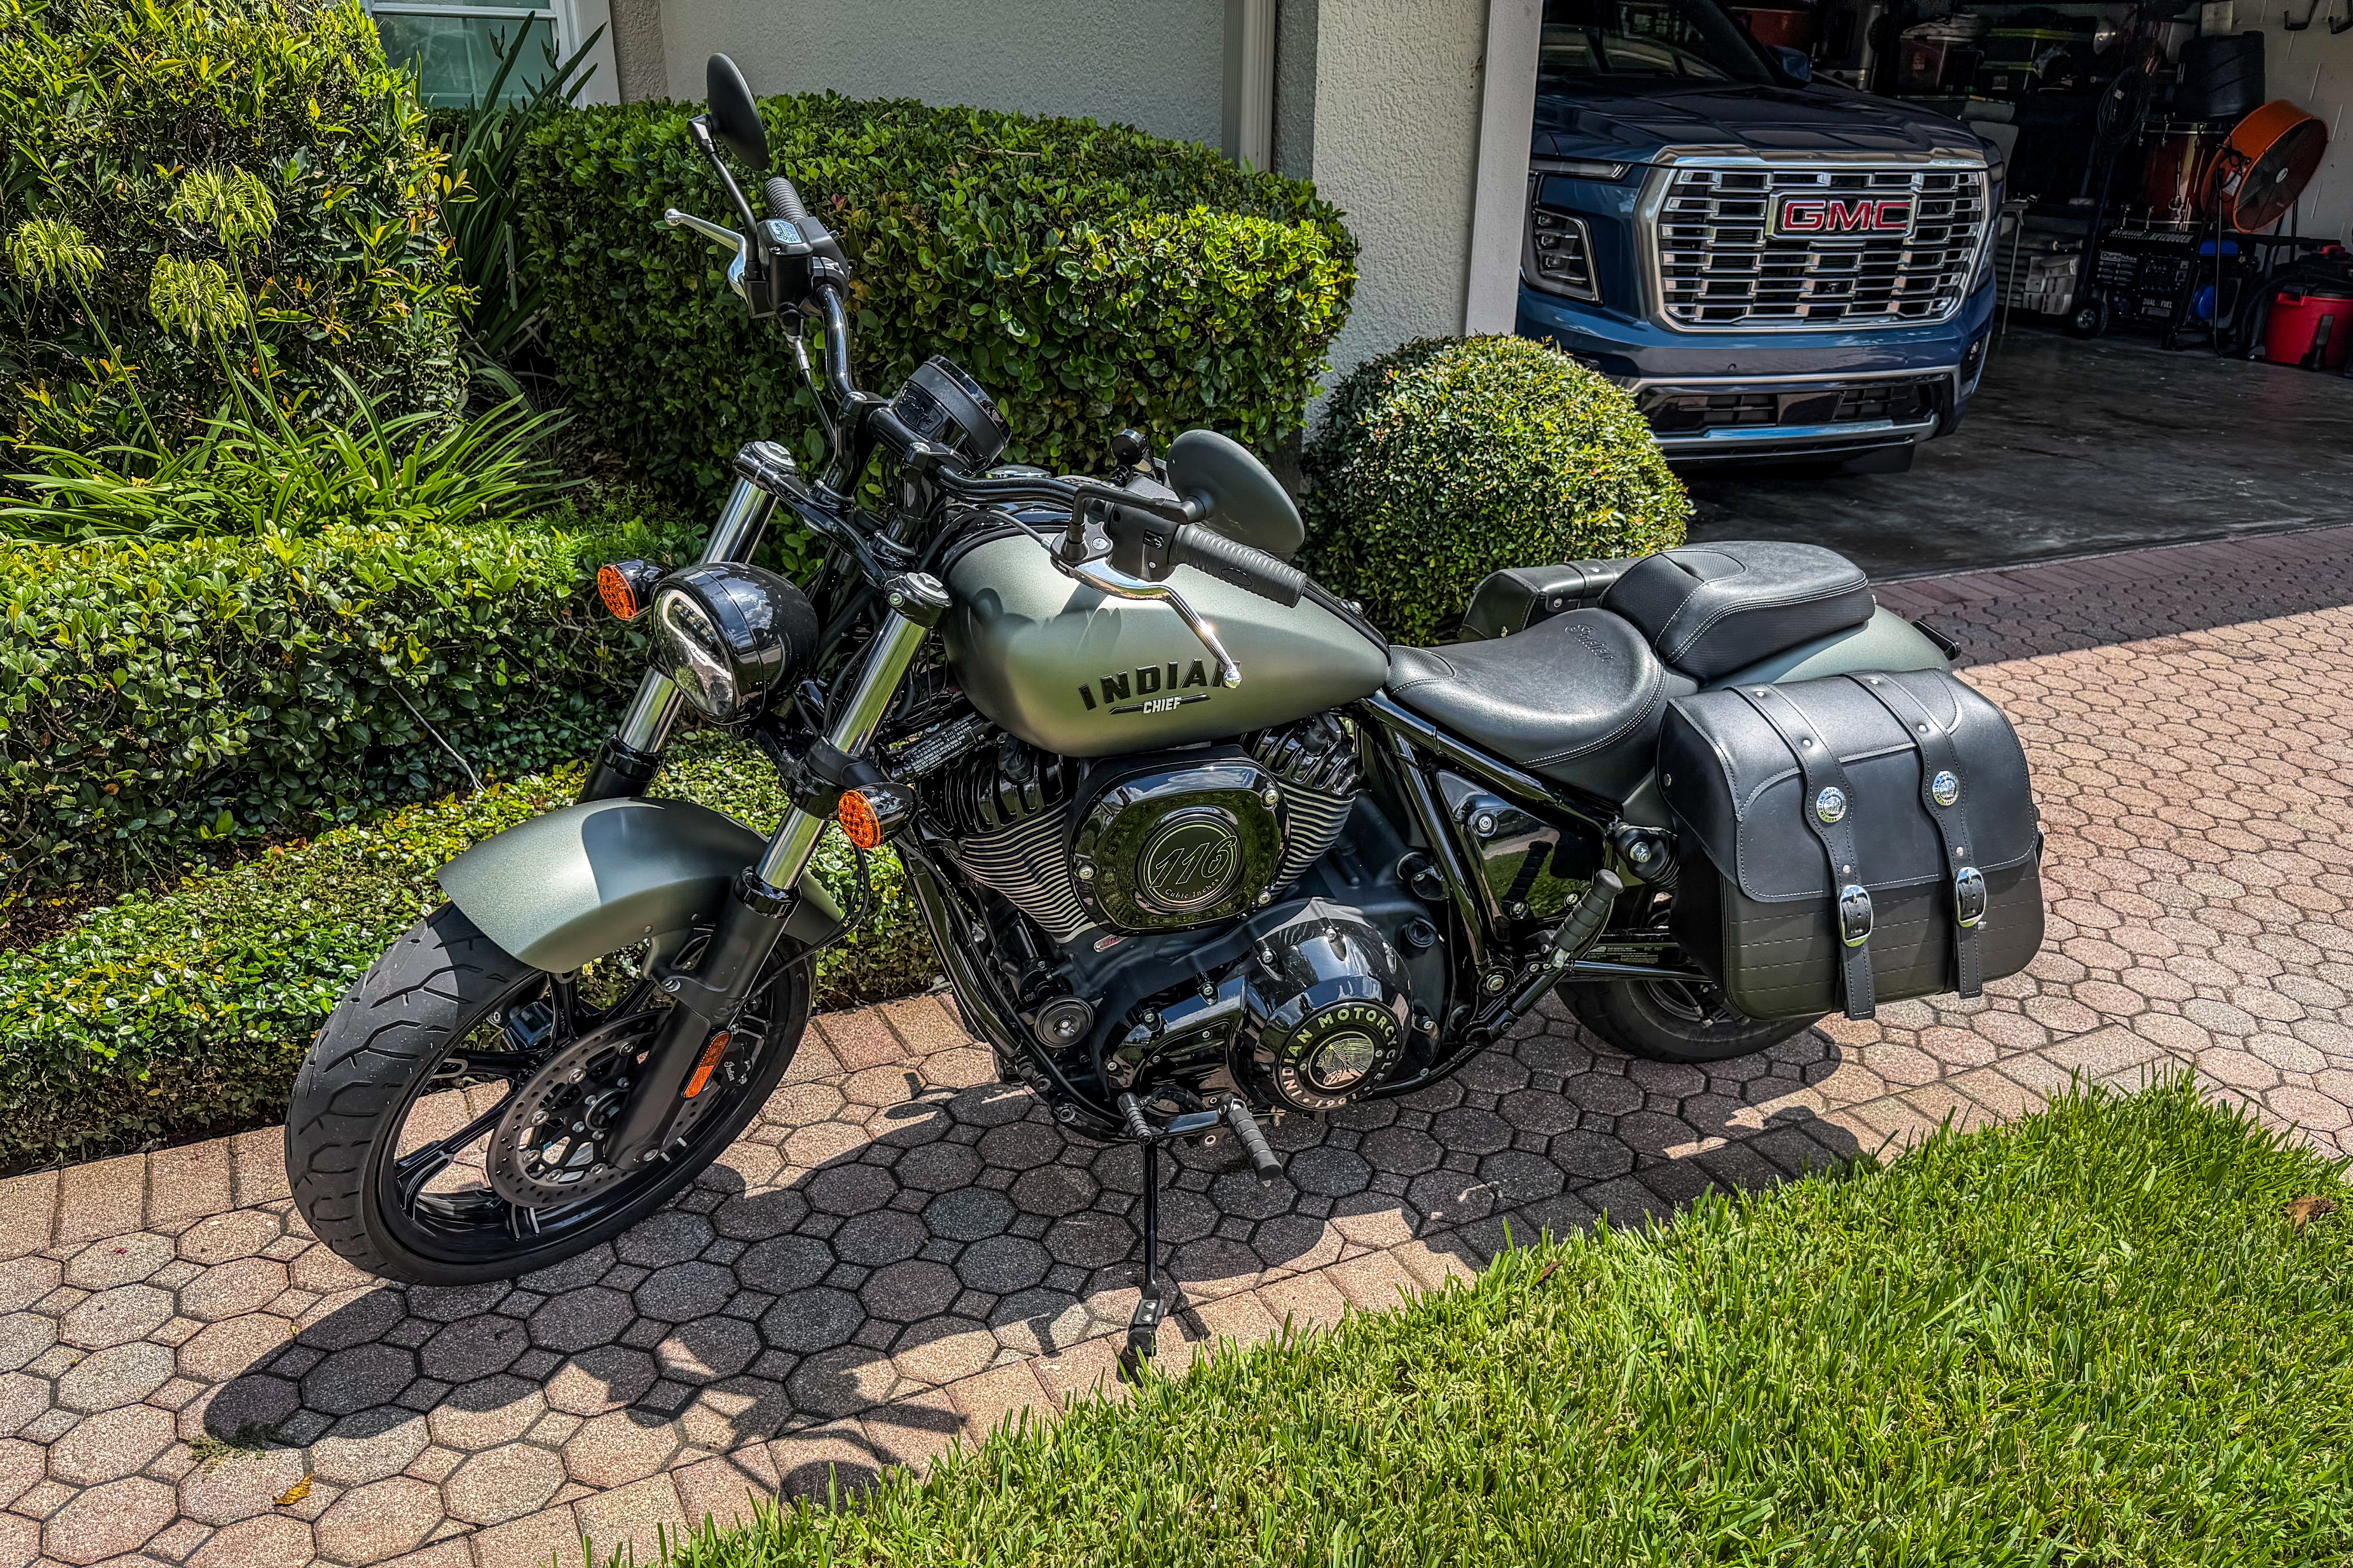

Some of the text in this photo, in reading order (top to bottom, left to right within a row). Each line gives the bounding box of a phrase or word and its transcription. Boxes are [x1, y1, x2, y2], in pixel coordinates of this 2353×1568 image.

[1782, 199, 1911, 230] GMC
[1565, 623, 1617, 663] Indian
[1143, 696, 1182, 715] CHIEF
[1151, 835, 1238, 889] 116
[1165, 879, 1219, 899] Cubic Inches
[1282, 1007, 1397, 1097] INDIAN MOTORCYCLE
[1315, 1093, 1357, 1107] 1901
